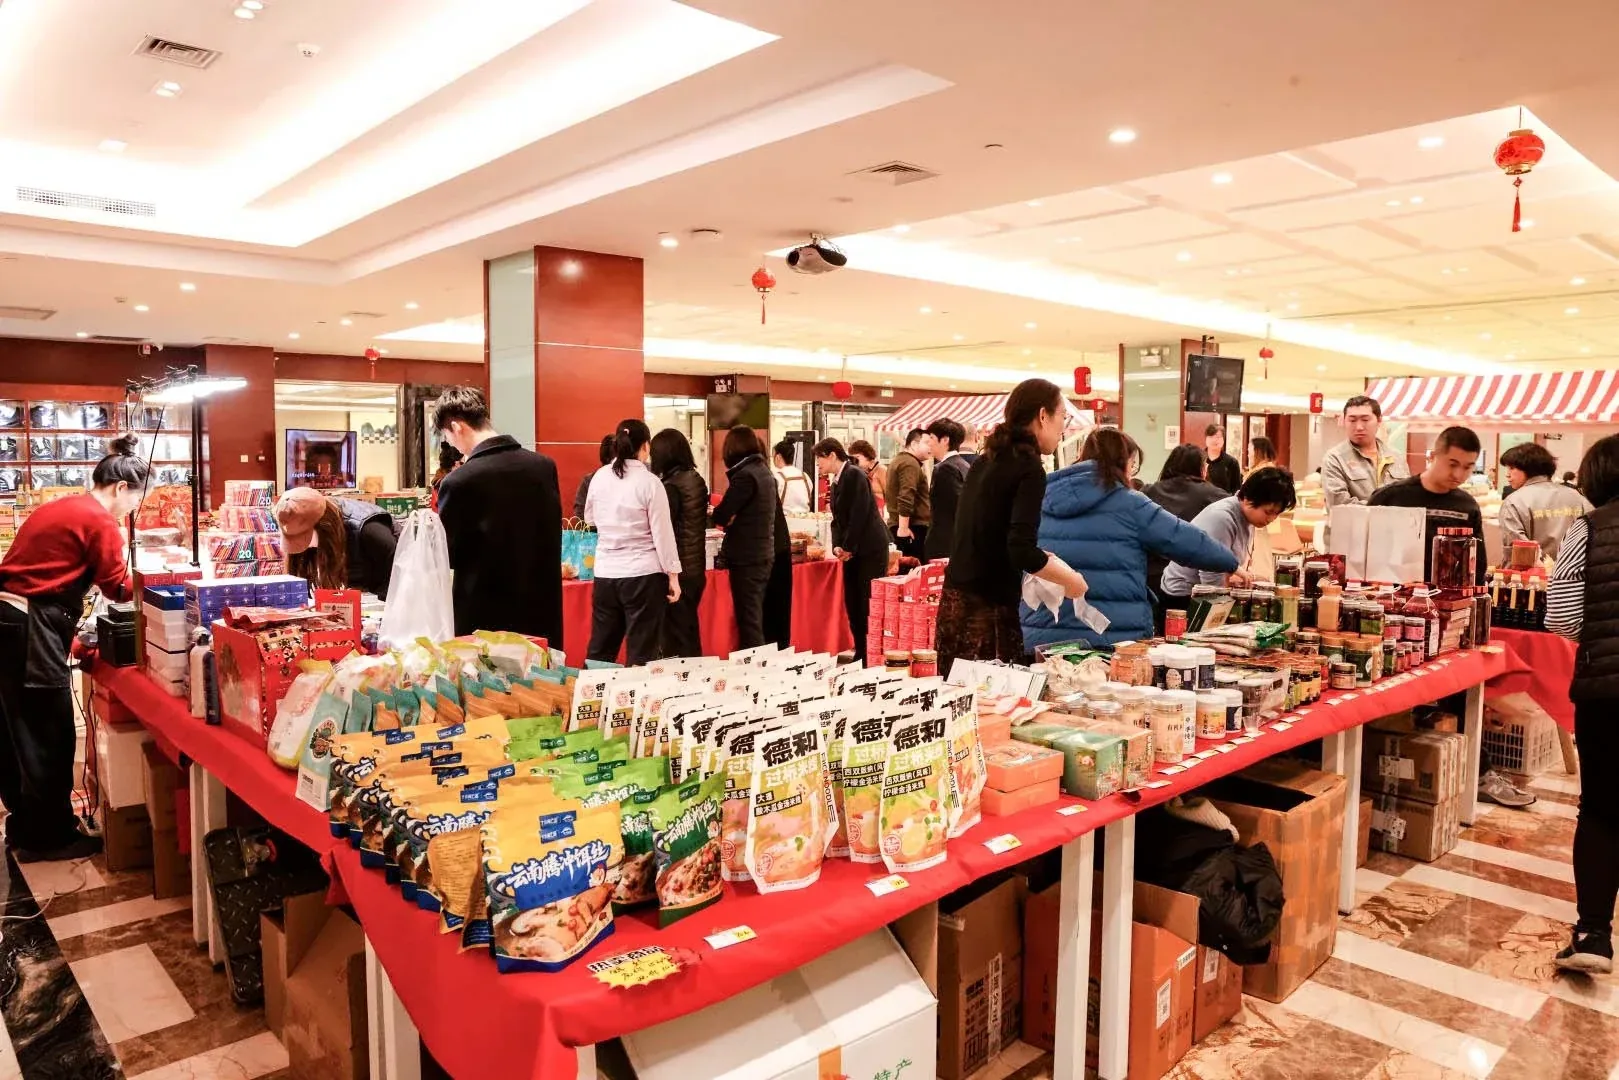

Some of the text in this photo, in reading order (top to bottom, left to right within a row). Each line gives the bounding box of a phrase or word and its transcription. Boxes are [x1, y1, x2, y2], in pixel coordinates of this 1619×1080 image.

[761, 729, 818, 767] 德和
[894, 718, 946, 752] 德和
[506, 841, 609, 888] 云南腾冲饵丝
